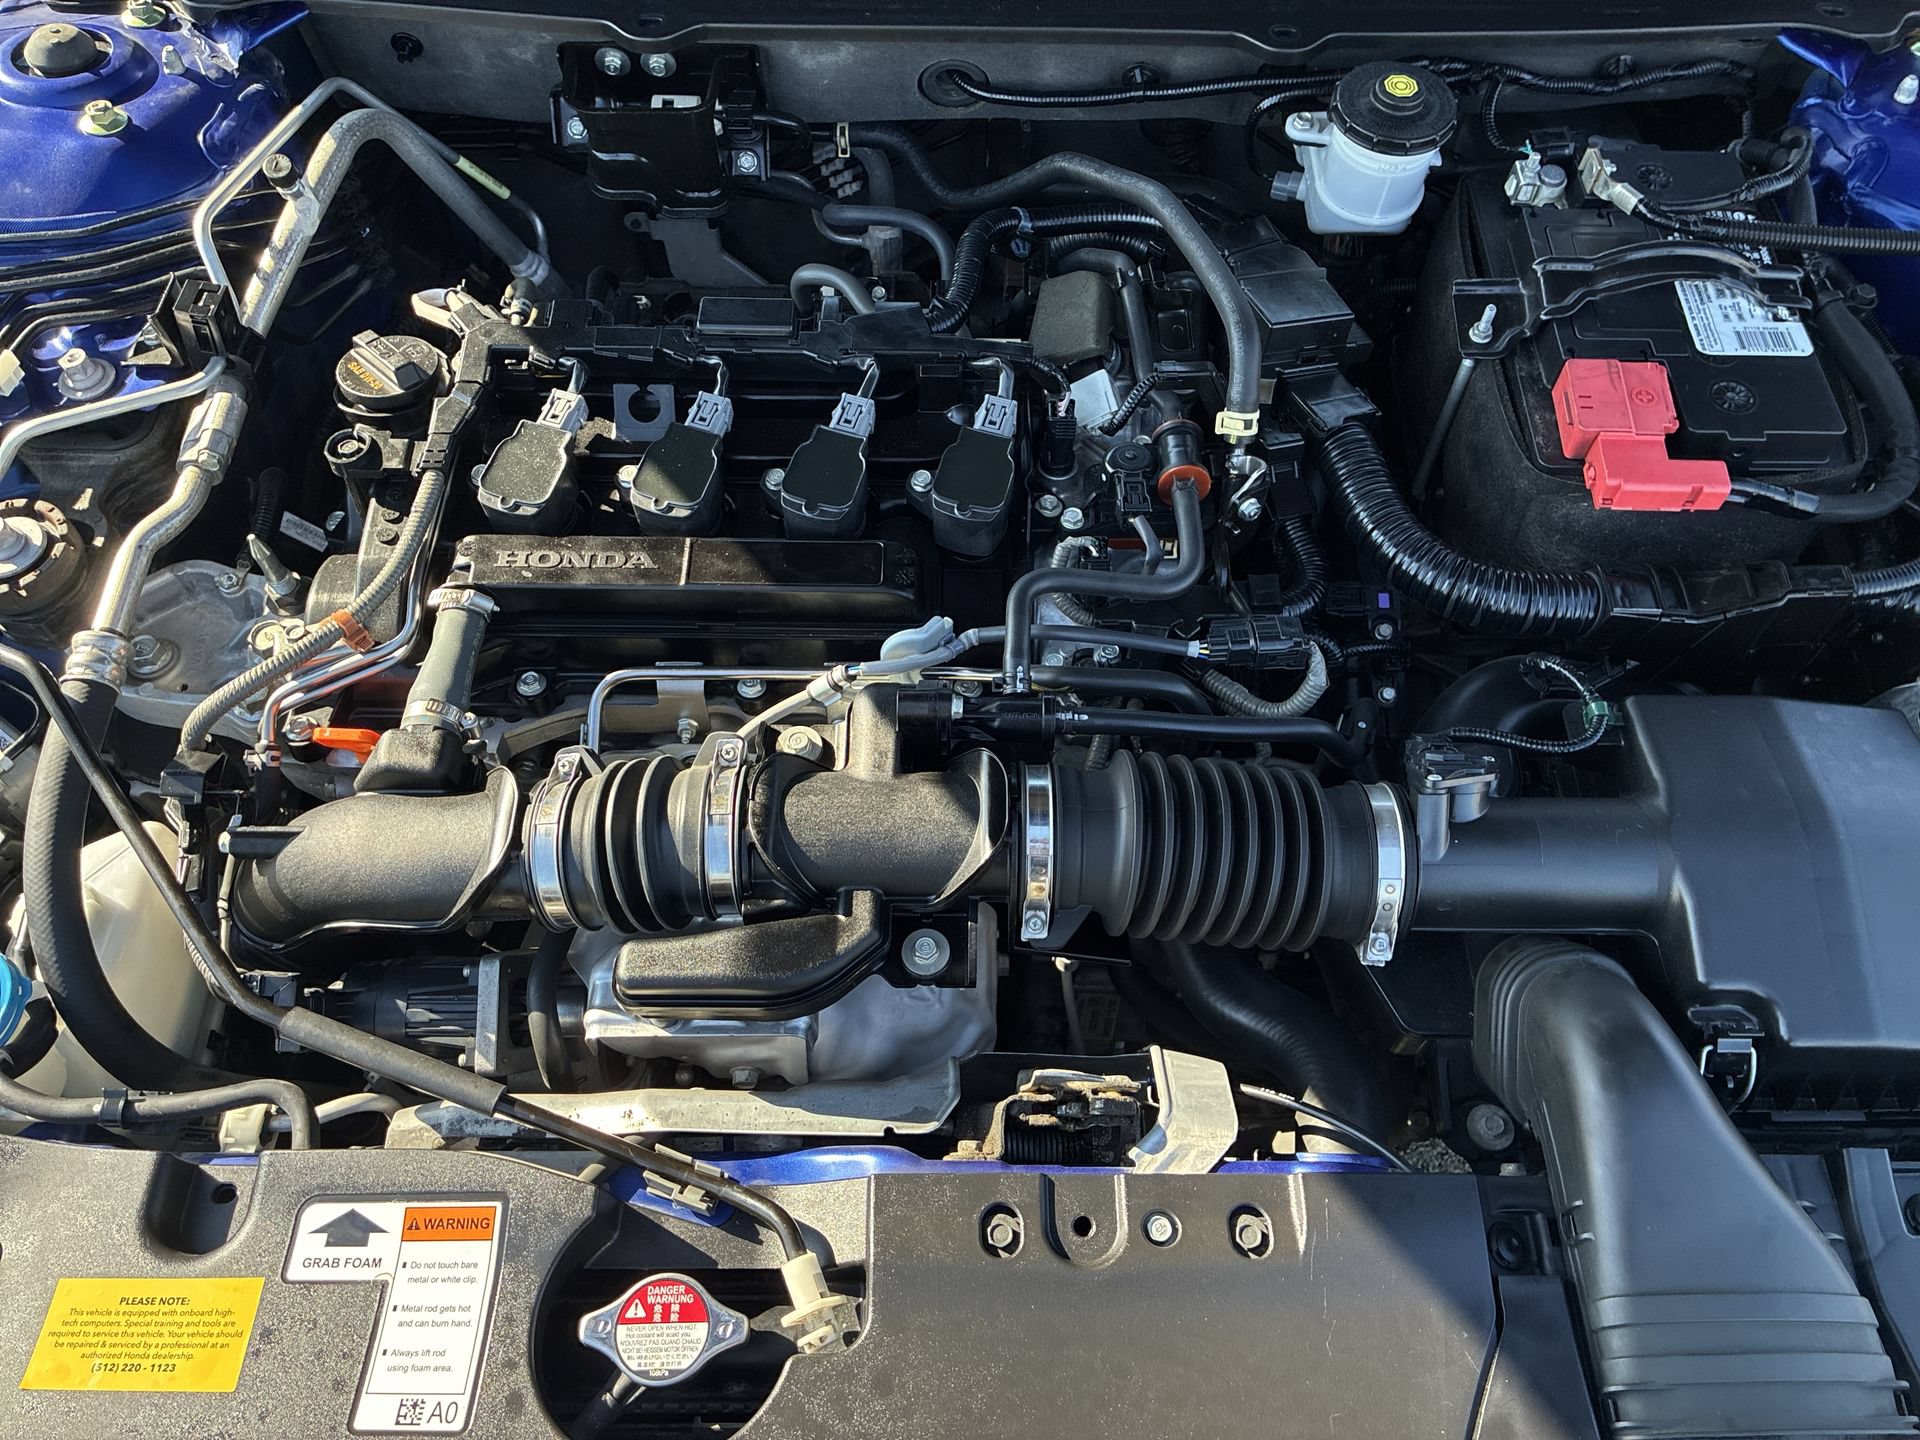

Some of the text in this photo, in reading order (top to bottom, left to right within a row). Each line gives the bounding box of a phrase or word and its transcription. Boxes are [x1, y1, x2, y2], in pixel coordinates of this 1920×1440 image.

[348, 361, 363, 377] SAE
[494, 550, 658, 569] HONDA
[424, 1217, 490, 1230] WARNING
[302, 1258, 382, 1268] GRAB FOAM
[411, 1261, 422, 1269] Do
[438, 1261, 459, 1269] touch
[461, 1261, 478, 1269] bare
[462, 1276, 478, 1285] clip.
[648, 1285, 685, 1294] DANGER
[119, 1296, 190, 1305] PLEASE NOTE:
[648, 1294, 694, 1304] WARNUNG
[69, 1308, 84, 1316] This
[86, 1308, 113, 1316] vehicle
[122, 1309, 160, 1318] equipped
[215, 1309, 235, 1318] high-
[439, 1305, 456, 1314] gets
[62, 1319, 78, 1327] tech
[79, 1320, 122, 1329] computers.
[124, 1319, 153, 1329] Special
[154, 1319, 184, 1329] training
[186, 1319, 200, 1327] and
[202, 1319, 221, 1327] tools
[48, 1330, 81, 1339] required
[121, 1330, 135, 1338] this
[137, 1330, 165, 1338] vehicle.
[168, 1330, 185, 1338] Your
[187, 1330, 214, 1338] vehicle
[216, 1330, 243, 1338] should
[66, 1341, 99, 1350] repaired
[142, 1341, 153, 1350] by
[161, 1341, 209, 1350] professional
[80, 1351, 195, 1361] authorized Honda dealership.
[391, 1349, 419, 1357] Always
[91, 1363, 120, 1373] (512)
[121, 1363, 142, 1372] 220
[150, 1363, 176, 1372] 1123
[387, 1364, 409, 1373] using
[411, 1364, 431, 1372] foam
[427, 1401, 458, 1424] A0
